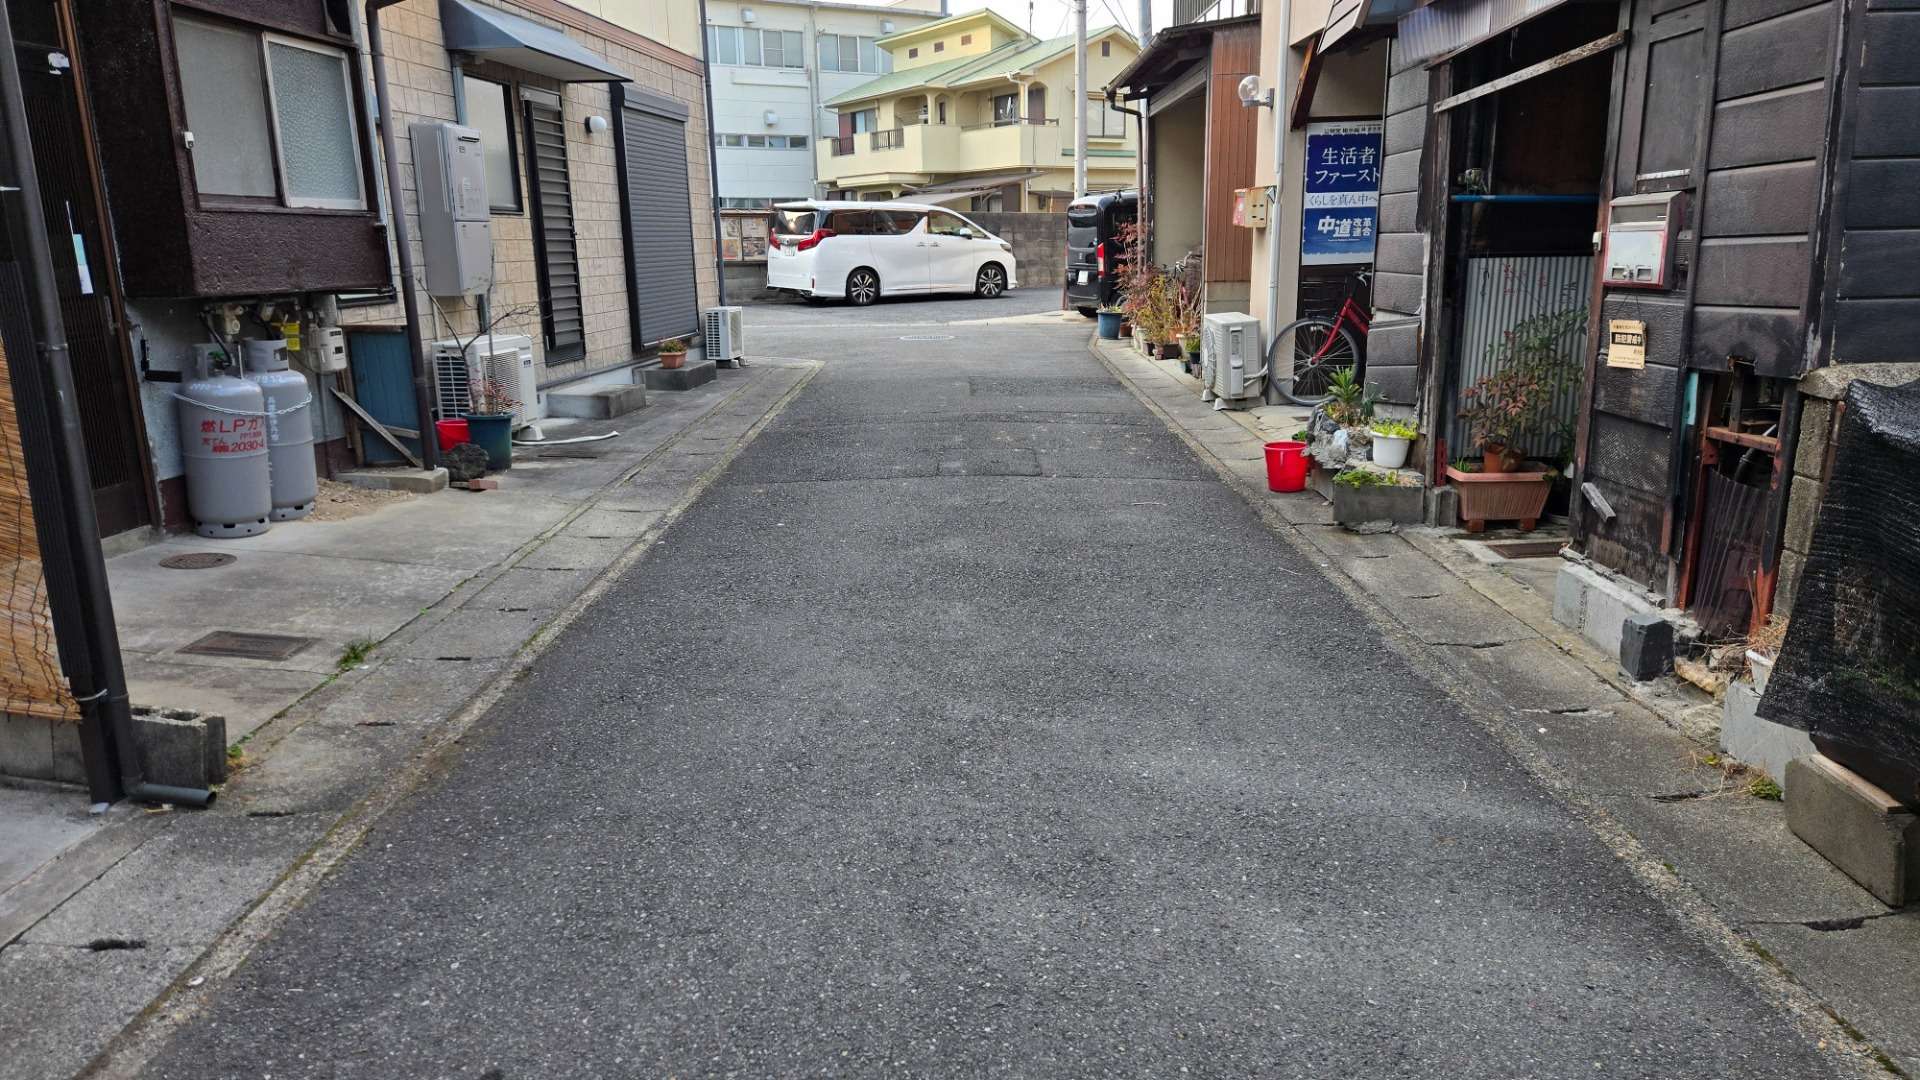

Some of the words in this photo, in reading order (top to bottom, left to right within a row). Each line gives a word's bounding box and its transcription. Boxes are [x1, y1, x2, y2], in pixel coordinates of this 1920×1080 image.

[1321, 147, 1376, 165] 生活者
[1315, 168, 1379, 184] ファースト
[1318, 216, 1352, 238] 中道
